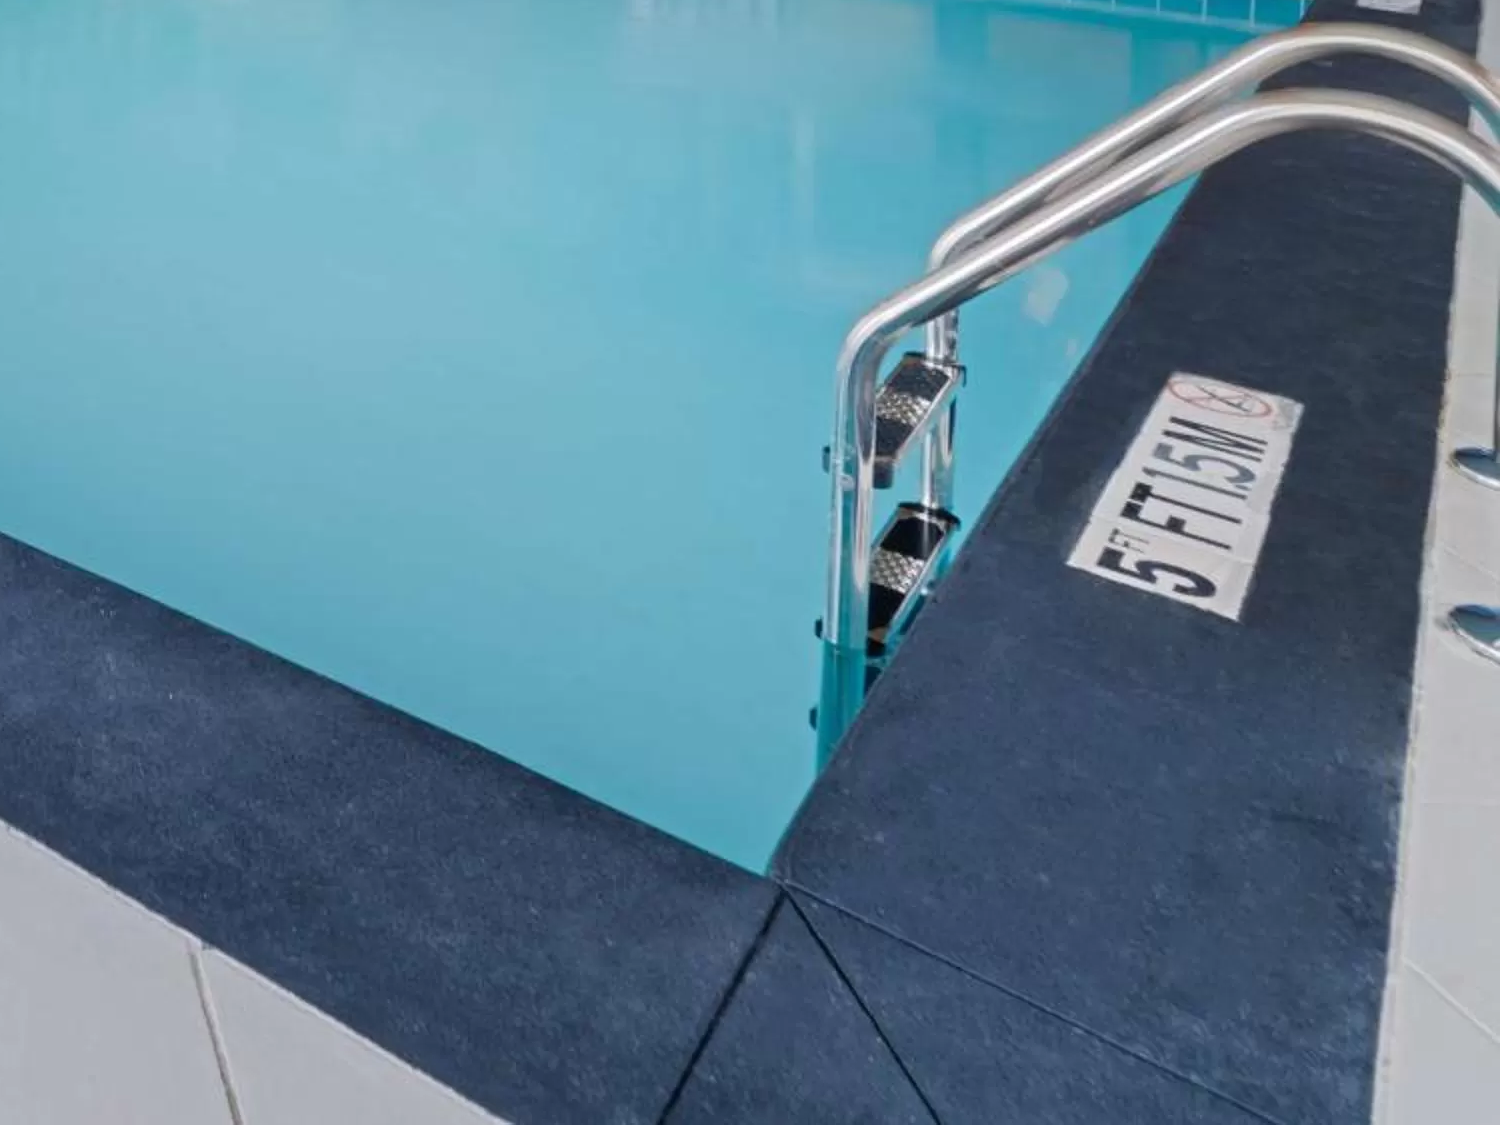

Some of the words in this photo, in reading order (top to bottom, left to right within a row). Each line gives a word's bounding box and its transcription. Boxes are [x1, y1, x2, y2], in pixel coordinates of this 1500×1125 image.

[1160, 415, 1268, 463] M
[1119, 481, 1243, 551] FT
[1096, 546, 1217, 598] 5
